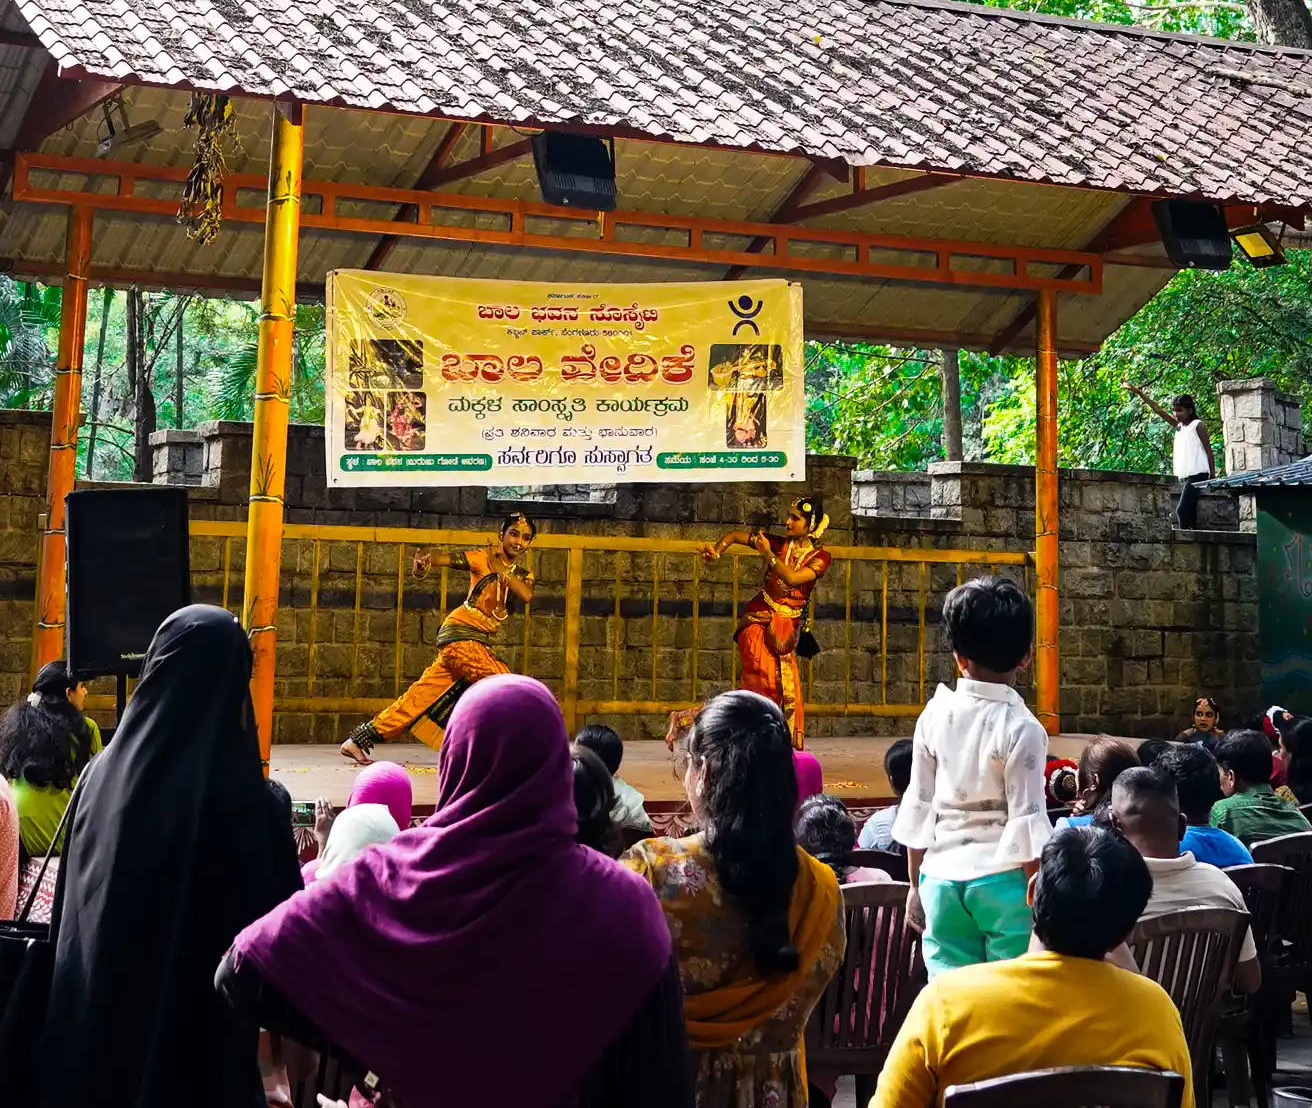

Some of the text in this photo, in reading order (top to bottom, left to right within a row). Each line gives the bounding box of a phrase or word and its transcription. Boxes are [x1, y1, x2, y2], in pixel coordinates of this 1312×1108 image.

[477, 303, 658, 330] ಬಾಲ ಭವನ ಸೊಸೈಟಿ
[441, 344, 696, 384] ಬಾಲ ವೇದಿಕೆ
[448, 396, 503, 419] ಮಕ್ಕಳ
[596, 395, 689, 417] ಕಾರ್ಯಕ್ರಮ
[510, 427, 557, 438] ಶನಿವಾರ
[562, 427, 593, 440] ಮತ್ತು
[497, 445, 653, 473] ಸರ್ವರಿಗೂ ಸುಸ್ವಾಗತ
